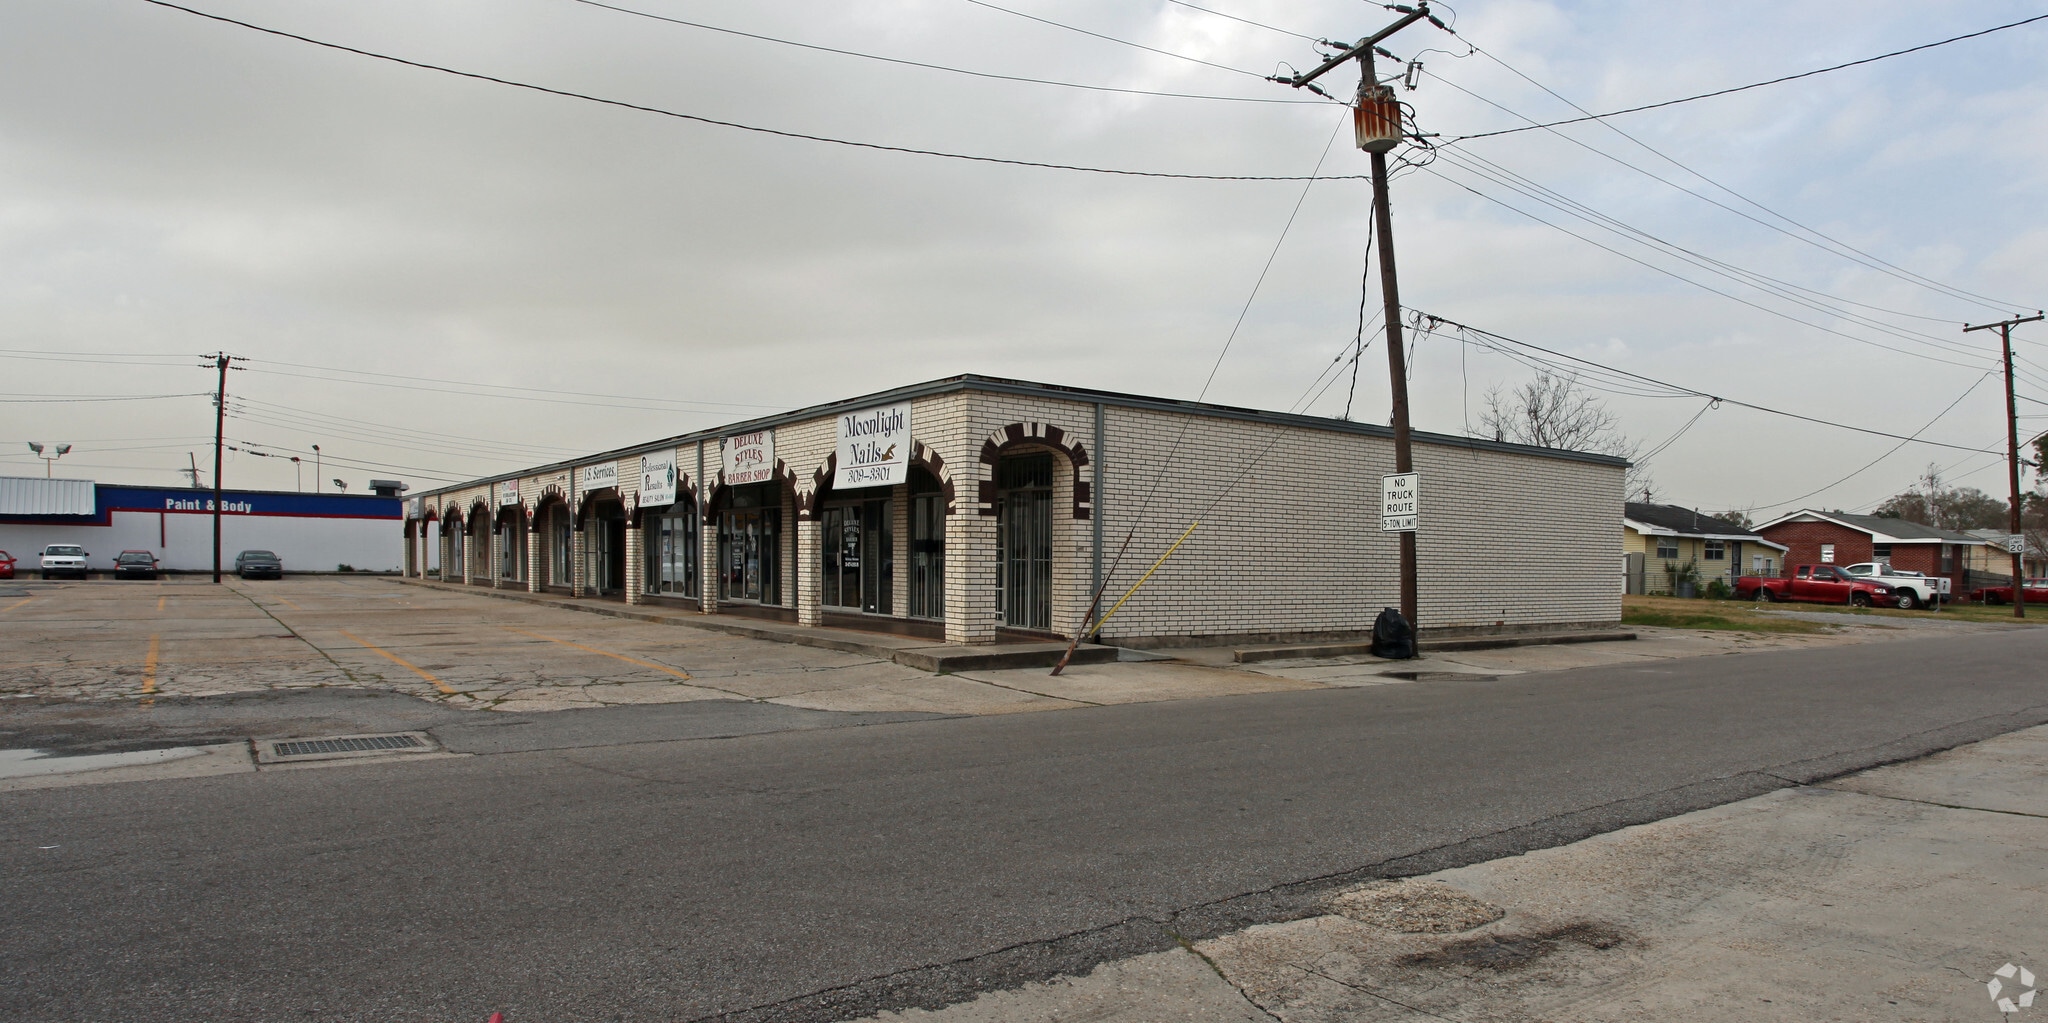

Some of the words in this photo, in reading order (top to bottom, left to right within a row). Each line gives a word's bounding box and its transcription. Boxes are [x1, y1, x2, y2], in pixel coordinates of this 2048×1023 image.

[844, 408, 904, 438] Moonlight
[734, 433, 763, 450] DELUXE
[735, 449, 763, 467] STYLES
[850, 441, 881, 466] Nails
[641, 456, 668, 474] Professional
[644, 474, 663, 491] Results
[728, 471, 752, 484] BARBER
[753, 468, 770, 481] SHOP
[848, 467, 891, 483] 309-3301
[1395, 479, 1405, 487] NO
[1387, 490, 1414, 500] TRUCK
[166, 498, 201, 510] Paint
[206, 500, 215, 511] &
[221, 500, 252, 514] Body
[1387, 502, 1413, 512] ROUTE
[1402, 518, 1416, 527] LIMIT
[2010, 544, 2023, 552] 20
